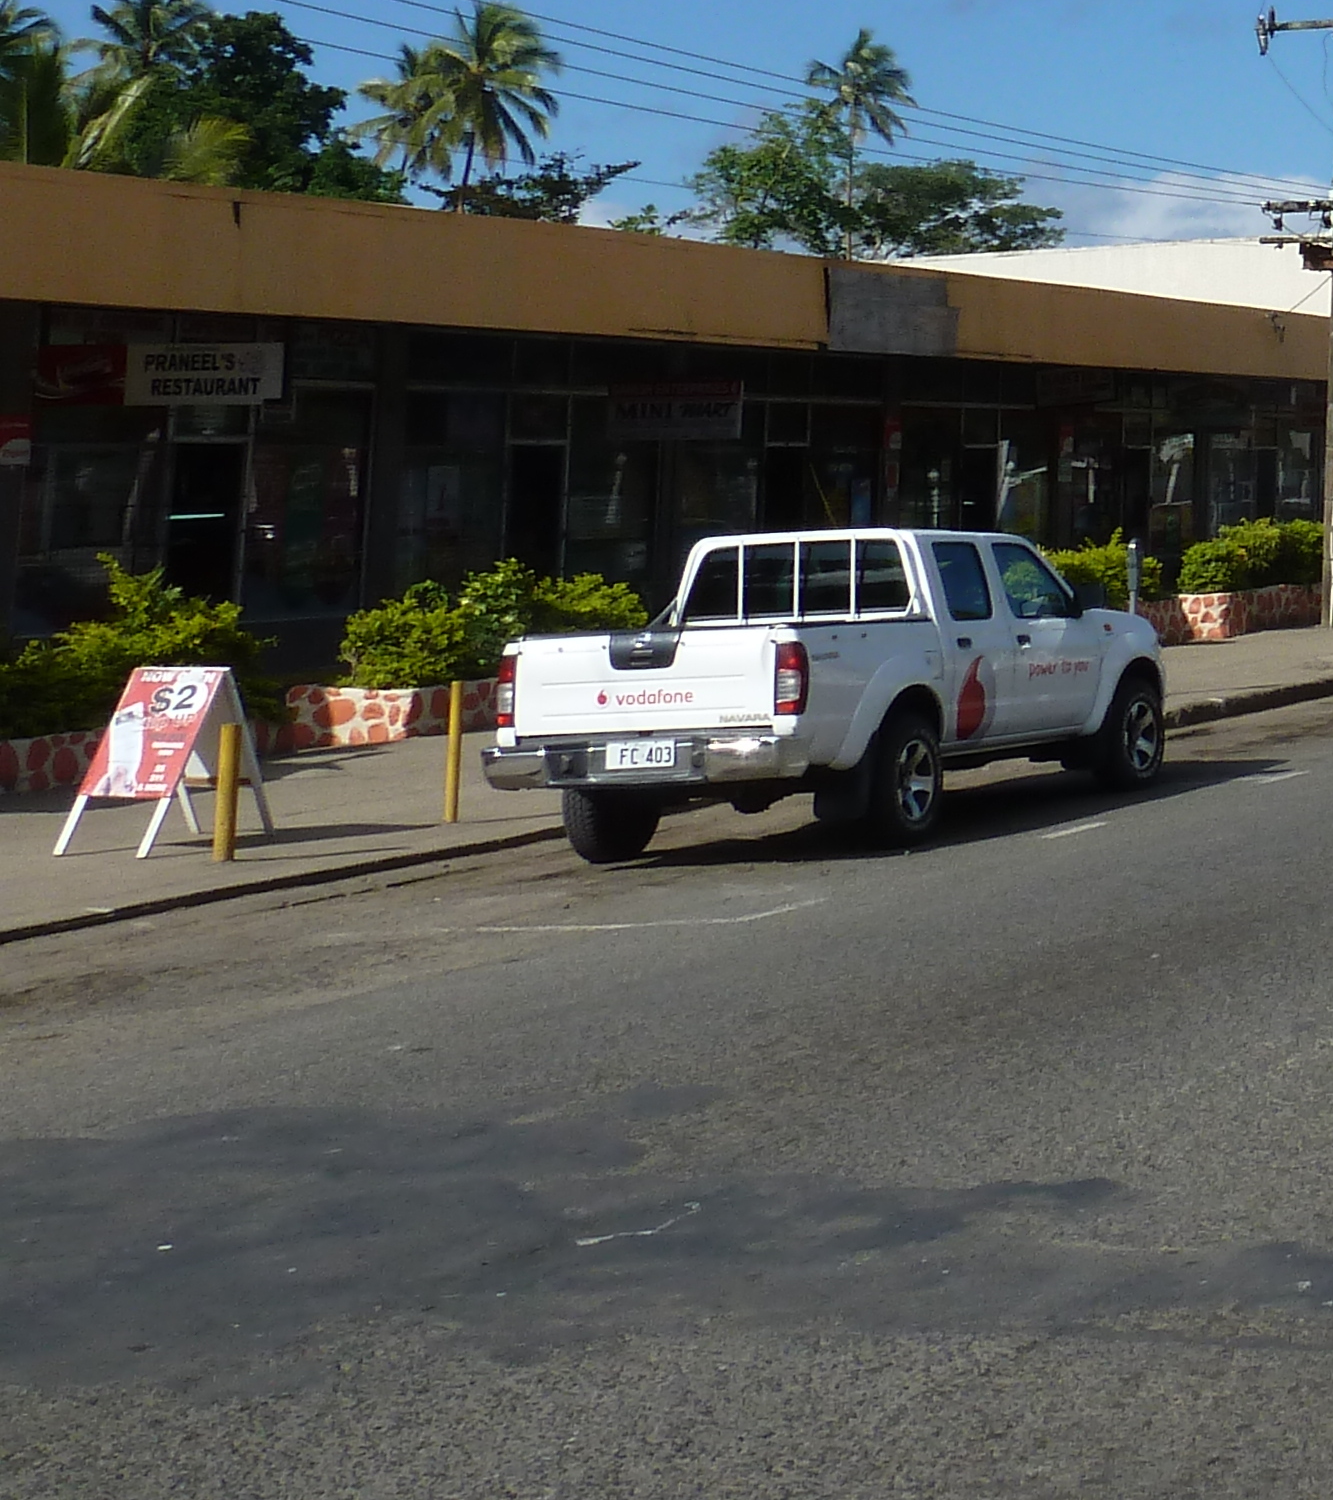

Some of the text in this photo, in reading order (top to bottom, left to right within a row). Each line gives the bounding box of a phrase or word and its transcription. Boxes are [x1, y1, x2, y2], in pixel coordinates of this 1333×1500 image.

[145, 353, 236, 372] PRANEEL'S
[152, 377, 262, 396] RESTAURANT
[617, 401, 672, 419] MINI
[150, 684, 198, 714] $2
[616, 689, 695, 706] vodafone
[719, 713, 771, 723] NAVARA
[619, 746, 673, 765] FC 403
